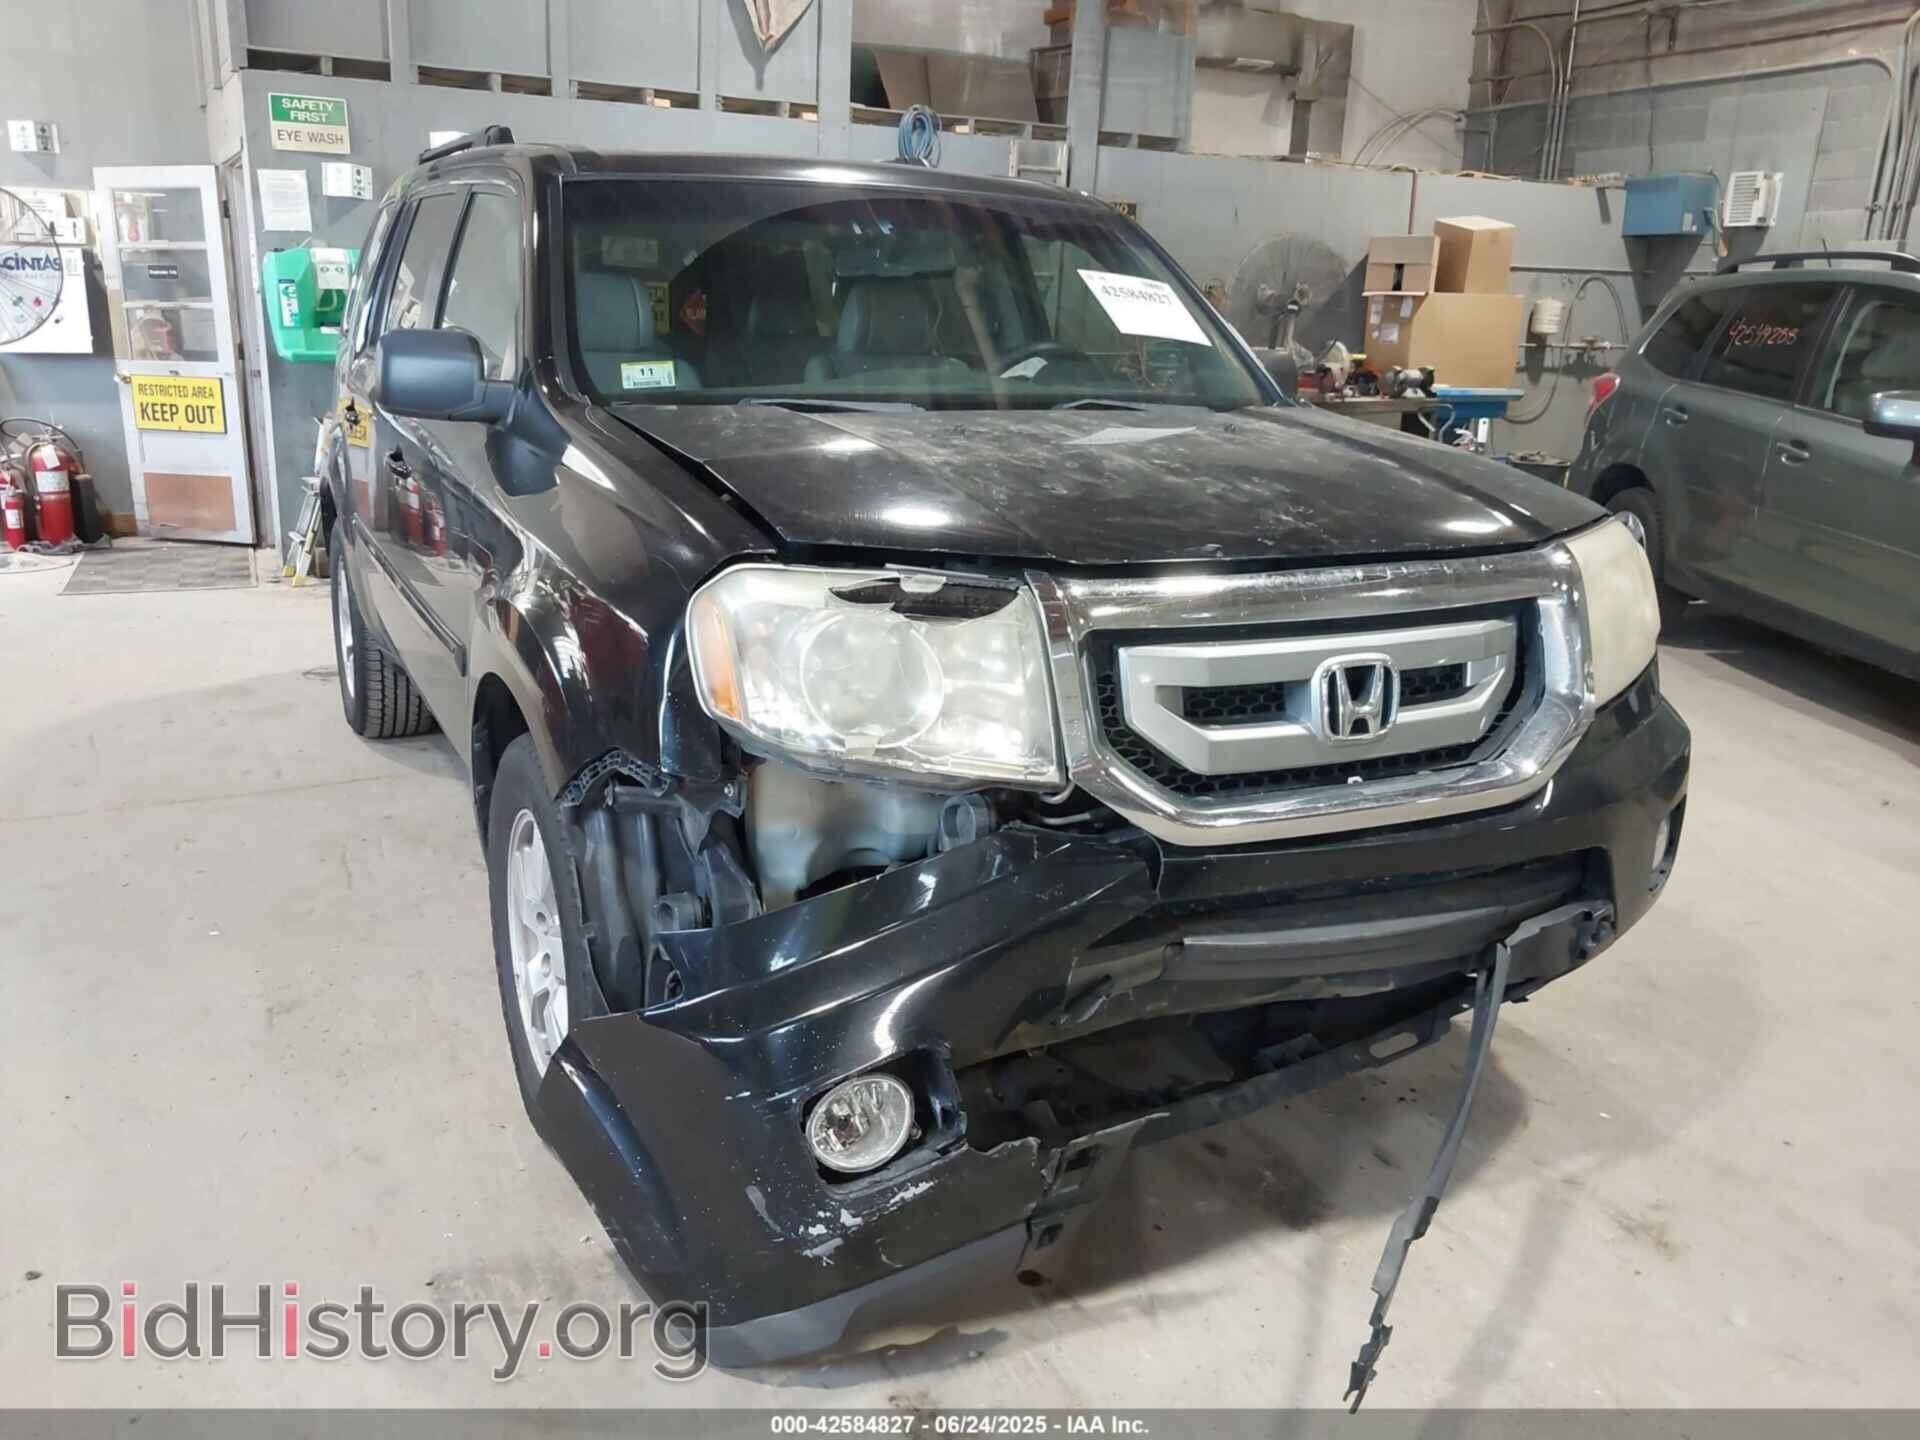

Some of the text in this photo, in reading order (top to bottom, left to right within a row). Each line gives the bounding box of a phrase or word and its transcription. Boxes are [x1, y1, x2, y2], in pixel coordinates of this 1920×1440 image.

[282, 97, 334, 112] SAFETY
[290, 110, 328, 123] FIRST
[277, 129, 343, 145] EYE WASH
[640, 367, 654, 377] 11
[138, 383, 214, 399] RESTRICTED AREA
[140, 401, 215, 424] KEEP OUT
